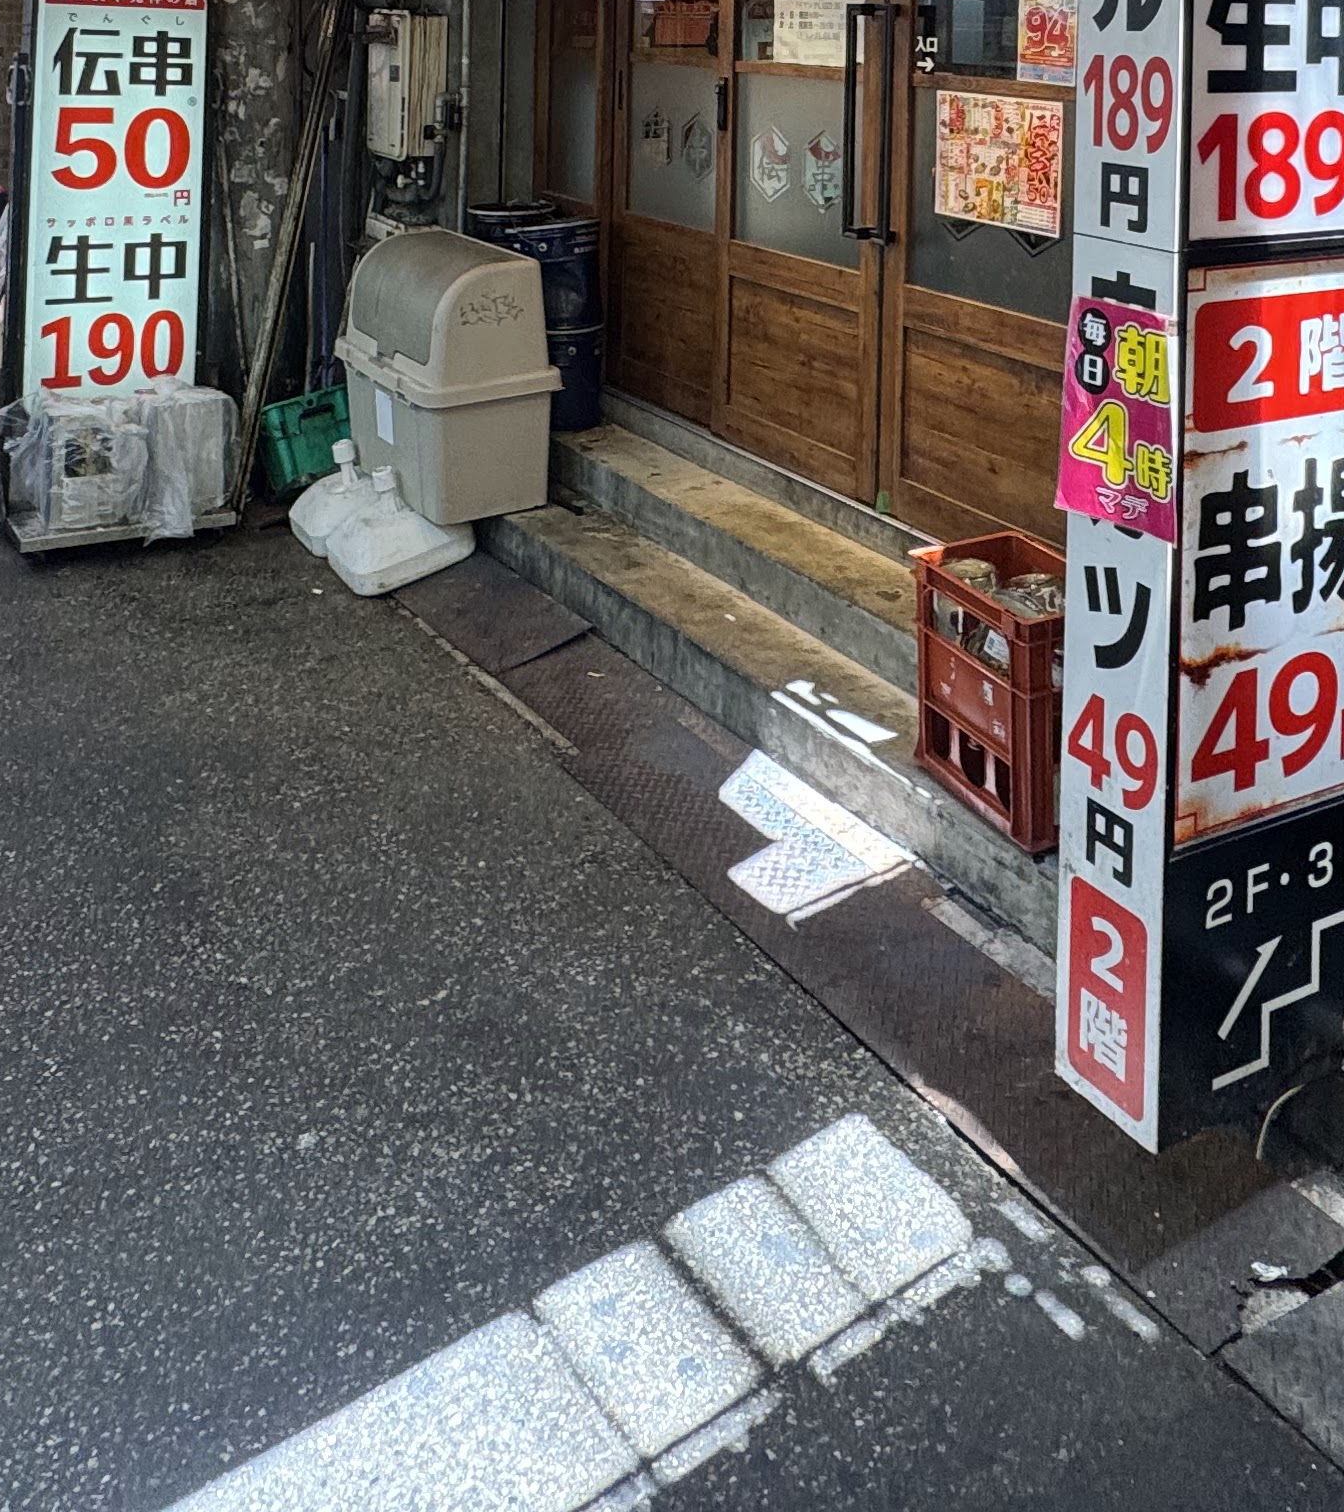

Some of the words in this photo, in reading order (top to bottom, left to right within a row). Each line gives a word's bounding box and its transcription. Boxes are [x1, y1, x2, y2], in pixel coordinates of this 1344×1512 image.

[67, 12, 185, 26] でんぐし
[915, 35, 939, 54] 入口
[52, 27, 193, 96] 伝串
[46, 215, 189, 228] サッポロ黒ラベル
[173, 189, 191, 206] 円
[45, 233, 188, 306] 生中
[41, 309, 185, 390] 190
[1082, 313, 1107, 386] 毎日
[1114, 322, 1171, 406] 朝
[1070, 400, 1173, 501] 4時
[1094, 486, 1150, 520] マデ
[1076, 914, 1130, 1084] 2階
